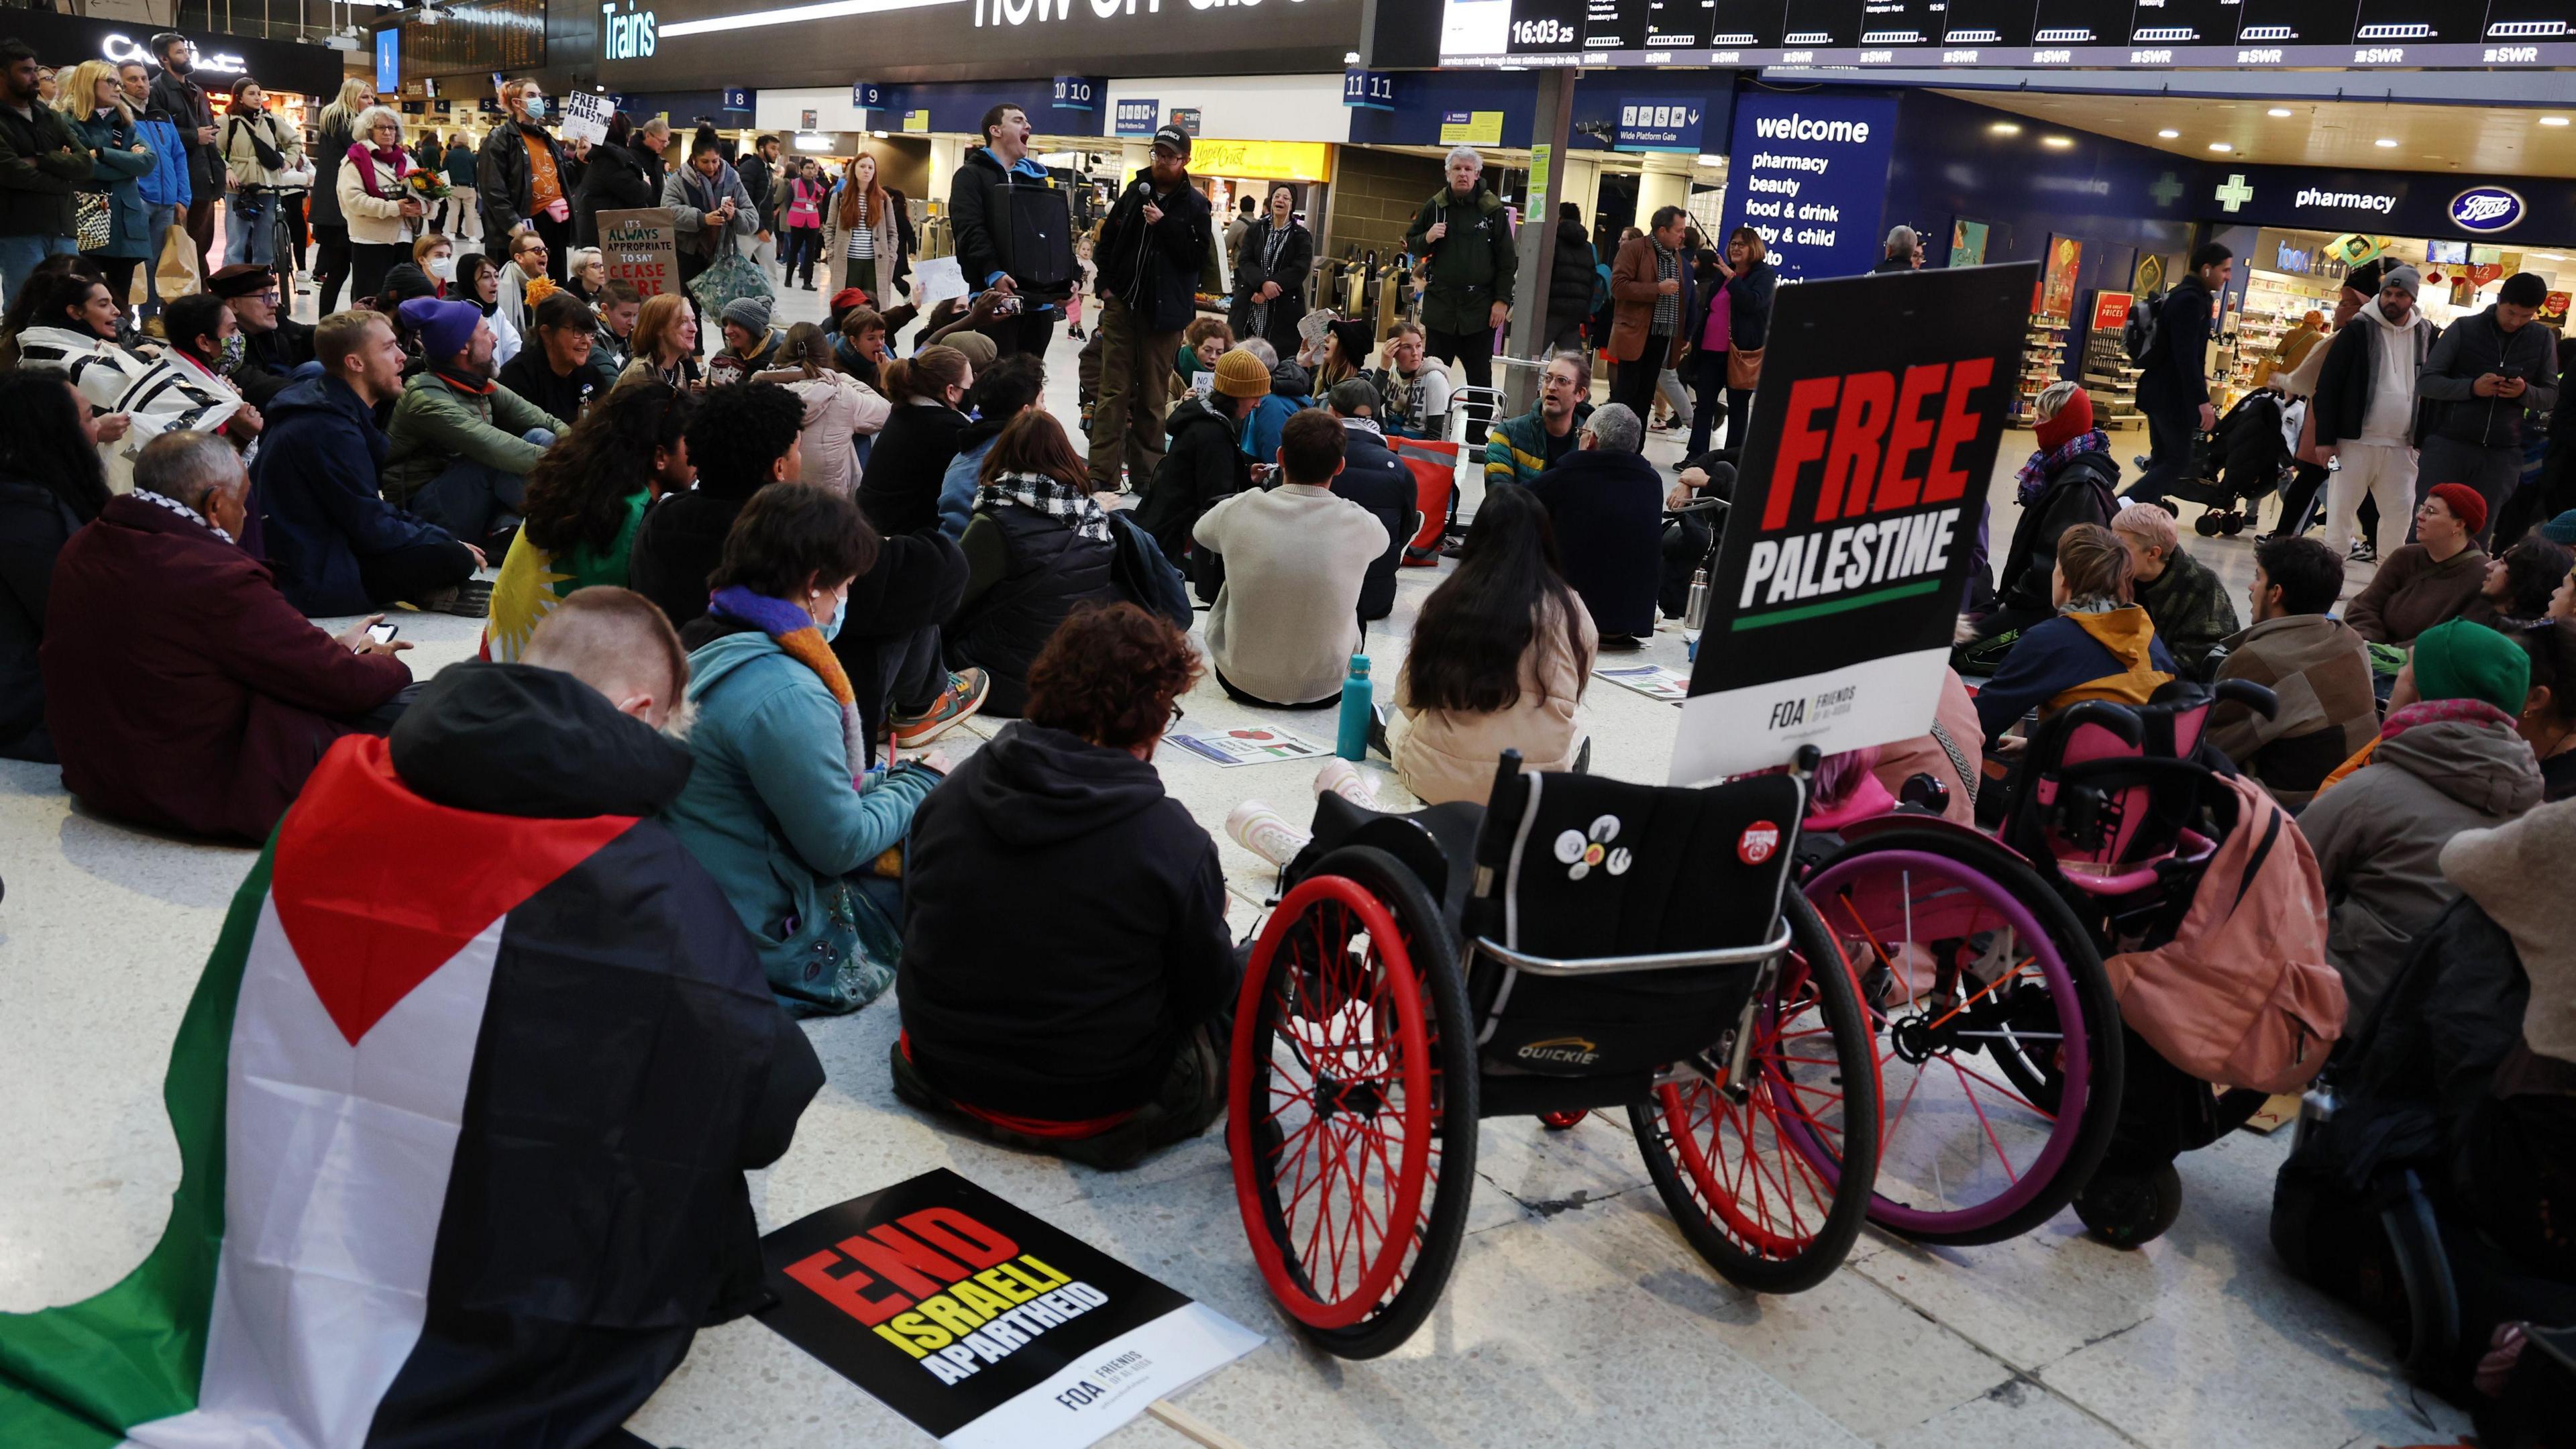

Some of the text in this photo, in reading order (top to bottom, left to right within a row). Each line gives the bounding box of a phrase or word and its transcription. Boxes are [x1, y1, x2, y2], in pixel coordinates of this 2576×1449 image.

[602, 0, 655, 60] Trains
[1513, 19, 1574, 44] 16:03 25
[1464, 58, 1484, 66] running
[1485, 57, 1506, 66] through
[1506, 56, 1521, 64] these
[1522, 56, 1543, 64] stations
[1544, 57, 1557, 66] may
[1557, 56, 1564, 64] be
[1591, 53, 1608, 63] SWR
[1652, 52, 1671, 62] SWR
[1718, 52, 1739, 62] SWR
[1791, 52, 1813, 62] SWR
[1869, 51, 1892, 62] SWR
[1952, 50, 1978, 62] SWR
[2043, 50, 2070, 62] SWR
[2141, 50, 2171, 62] SWR
[2249, 50, 2282, 62] SWR
[2367, 48, 2403, 62] SWR
[2497, 48, 2537, 62] SWR
[855, 87, 878, 103] 9 9
[1055, 82, 1091, 101] 10 10
[1347, 75, 1392, 99] 11 11
[439, 102, 443, 110] 4
[544, 100, 550, 108] 6
[572, 92, 599, 110] FREE
[615, 97, 622, 106] 7
[736, 93, 744, 105] 8
[568, 104, 612, 127] PALESTINE
[1620, 131, 1677, 141] Wide Platform Gate
[1756, 113, 1870, 143] welcome
[1194, 144, 1246, 168] Upper Crust
[1752, 151, 1829, 174] pharmacy
[1749, 174, 1800, 197] beauty
[2295, 188, 2396, 214] pharmacy
[2456, 195, 2512, 221] Boots
[1746, 199, 1839, 222] food & drink
[625, 220, 641, 228] IT'S
[608, 229, 658, 241] ALWAYS
[1782, 227, 1793, 243] &
[1797, 228, 1835, 247] child
[607, 241, 672, 252] APPROPRIATE
[621, 254, 653, 262] TO SAY
[2277, 239, 2314, 274] food
[610, 264, 665, 278] CEASE
[1197, 376, 1208, 384] NO
[1761, 357, 1995, 531] FREE
[1739, 507, 1961, 609] PALESTINE
[1768, 686, 1856, 730] FOA FRIENDS
[1517, 1046, 1595, 1064] QUICKIE
[783, 1207, 1019, 1327] END
[873, 1254, 1072, 1359] ISRAELI
[920, 1281, 1109, 1385] APARTHEID
[1120, 1359, 1153, 1379] AL-AQSA
[1055, 1381, 1106, 1411] FOA
[1095, 1350, 1142, 1378] FRIENDS
